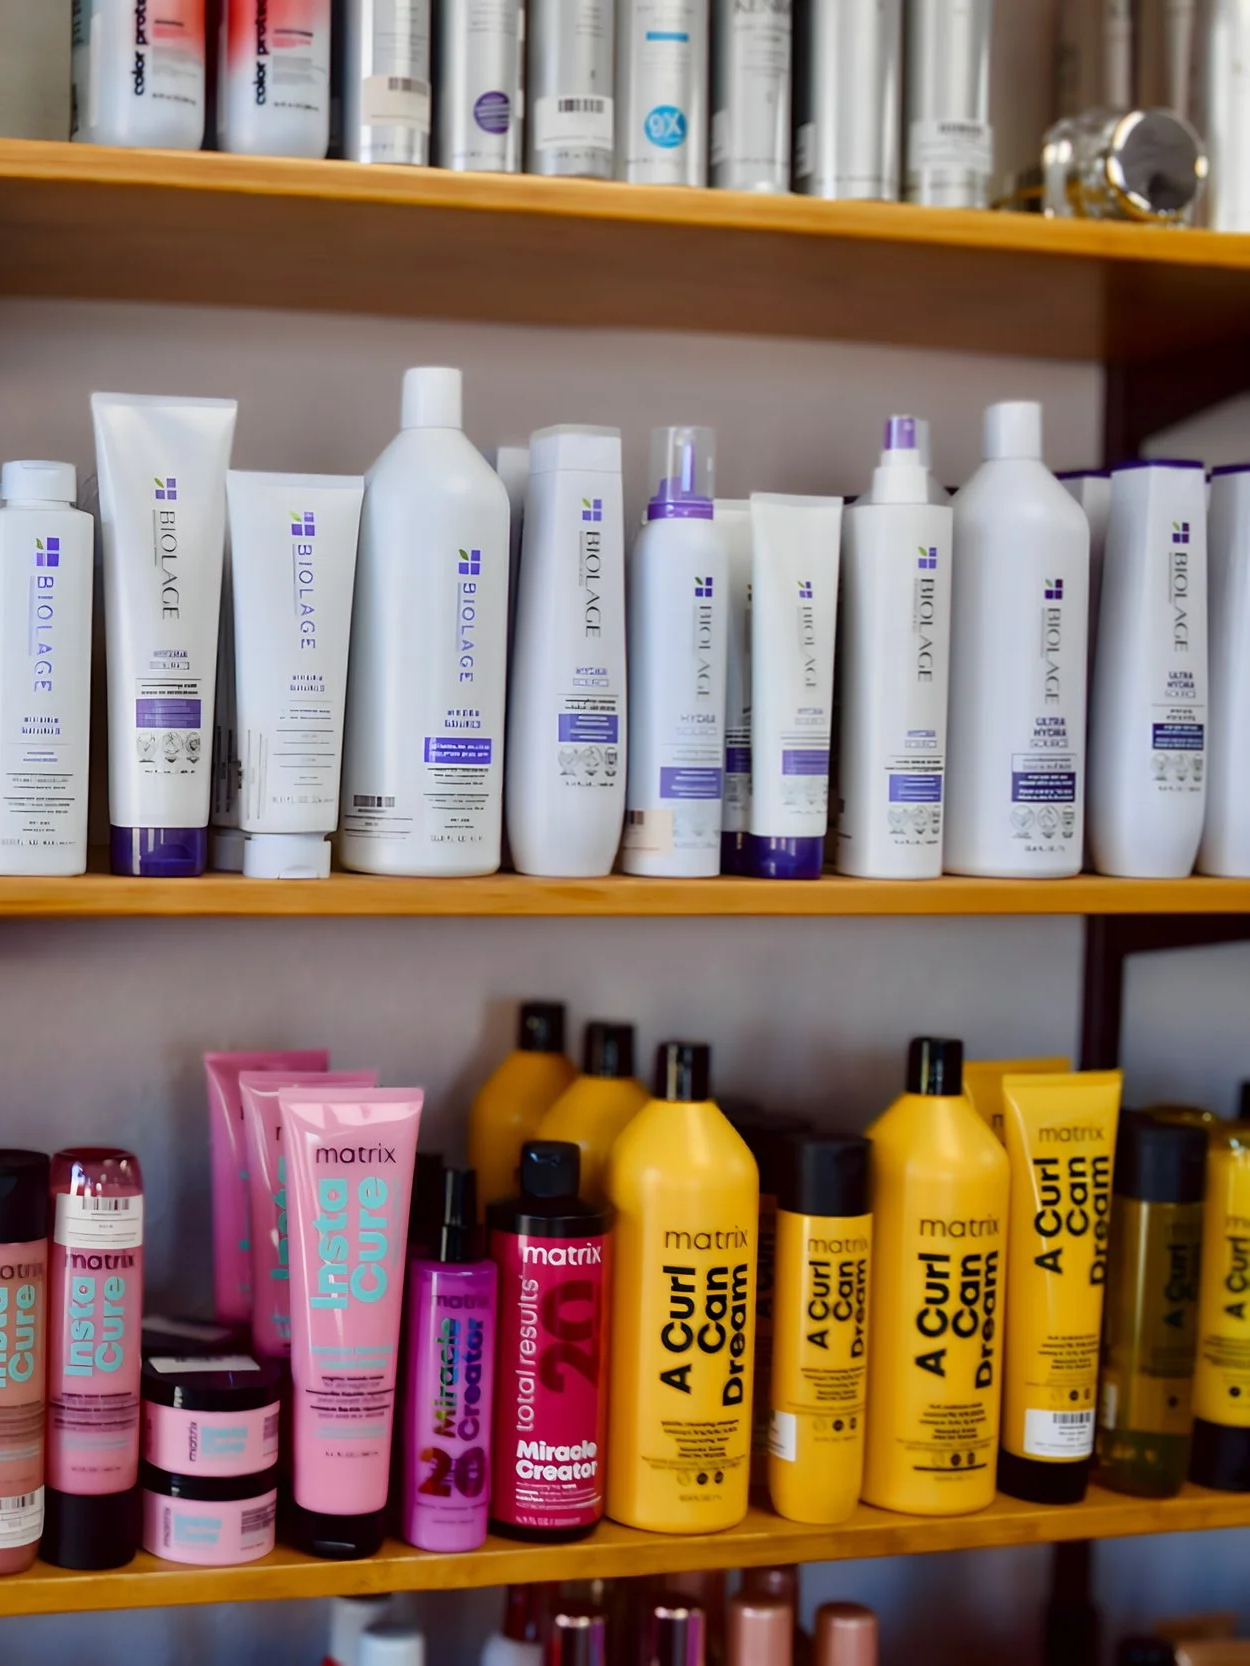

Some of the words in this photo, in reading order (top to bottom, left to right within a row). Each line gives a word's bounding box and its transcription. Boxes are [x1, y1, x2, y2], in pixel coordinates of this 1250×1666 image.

[131, 51, 146, 96] color
[252, 60, 267, 105] color
[160, 510, 180, 620] BIOLAGE
[297, 544, 317, 650] BIOLAGE
[586, 531, 601, 638] BIOLAGE
[1174, 552, 1189, 653] BIOLAGE
[34, 576, 54, 693] BIOLAGE
[461, 582, 477, 683] BIOLAGE
[918, 579, 935, 683] BIOLAGE
[1046, 608, 1062, 706] BIOLAGE
[315, 1143, 397, 1165] matrix
[1038, 1123, 1105, 1143] matrix
[350, 1176, 390, 1303] Cure
[664, 1225, 748, 1250] matrix
[920, 1213, 1000, 1239] matrix
[1033, 1158, 1063, 1239] Curl
[1066, 1156, 1090, 1237] Can
[1089, 1156, 1109, 1286] Dream
[310, 1178, 350, 1310] Insta
[523, 1243, 602, 1266] matrix
[1034, 1248, 1063, 1275] A
[1225, 1236, 1249, 1293] Curl
[8, 1284, 35, 1383] Cure
[64, 1276, 95, 1376] Insta
[94, 1276, 125, 1372] Cure
[519, 1277, 540, 1366] results
[661, 1265, 696, 1353] Curl
[698, 1266, 729, 1354] Can
[808, 1260, 831, 1321] Curl
[833, 1261, 854, 1322] Can
[850, 1259, 867, 1358] Dream
[916, 1253, 951, 1338] Curl
[952, 1253, 982, 1339] Can
[975, 1251, 998, 1390] Dream
[1224, 1301, 1245, 1320] A
[433, 1316, 461, 1438] Miracle
[722, 1263, 748, 1406] Dream
[806, 1330, 829, 1350] A
[915, 1348, 947, 1377] A
[457, 1318, 484, 1441] Creator
[516, 1369, 535, 1432] total
[660, 1364, 692, 1395] A
[418, 1446, 486, 1498] 20
[516, 1440, 598, 1462] Miracle
[516, 1459, 599, 1481] Creator
